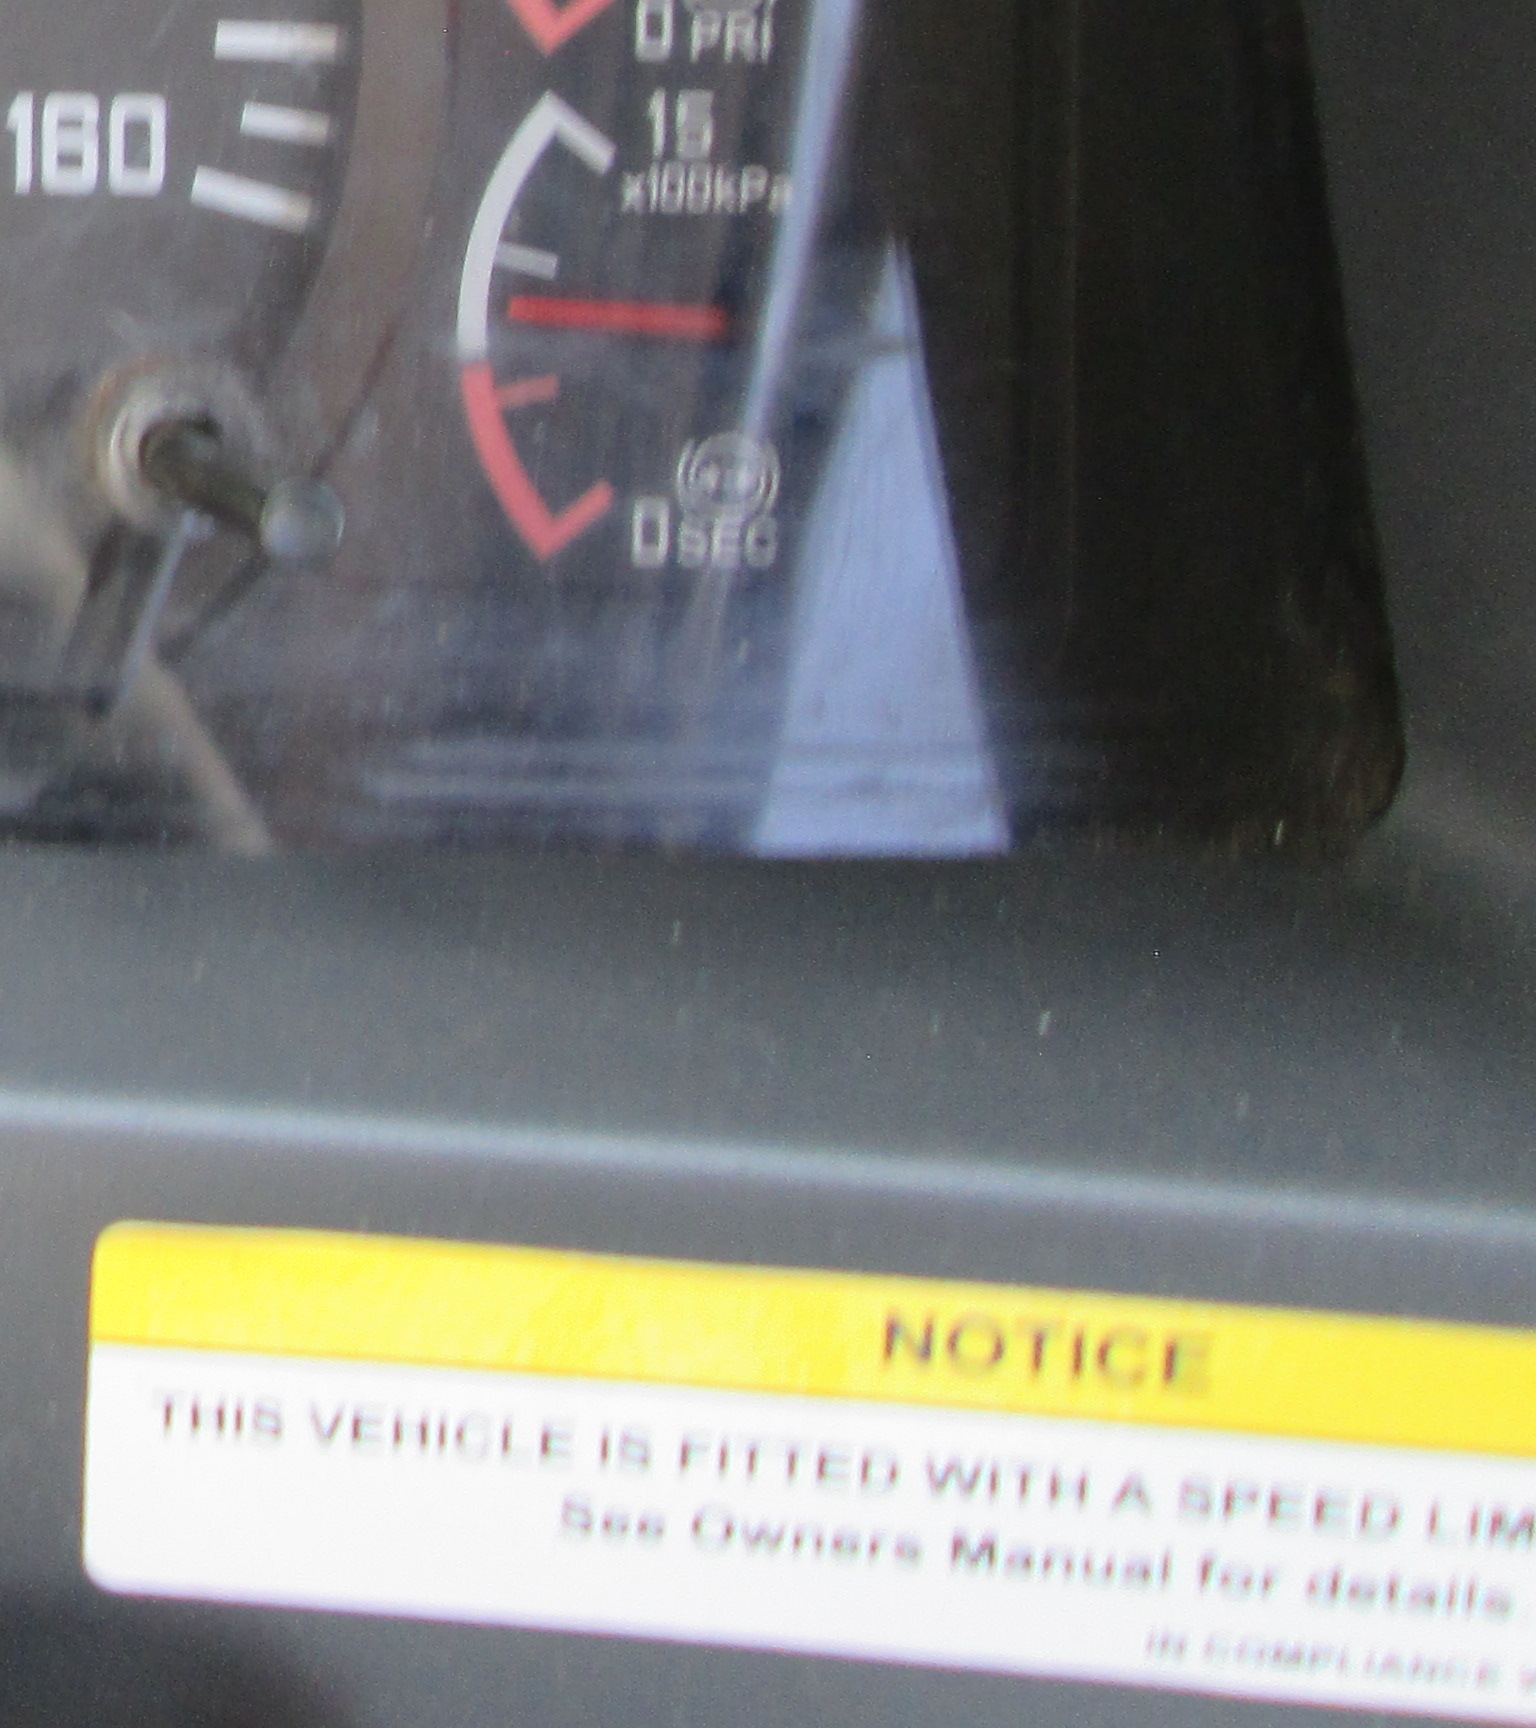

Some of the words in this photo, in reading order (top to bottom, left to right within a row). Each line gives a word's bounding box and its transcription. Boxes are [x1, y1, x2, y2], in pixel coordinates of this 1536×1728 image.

[691, 9, 773, 64] PRI
[8, 92, 168, 196] 160
[647, 90, 714, 160] 15
[631, 494, 671, 569] 0
[881, 1310, 1212, 1392] NOTICE
[153, 1389, 284, 1444] THIS
[308, 1398, 574, 1468] VEHICLE
[599, 1422, 651, 1475] IS
[678, 1430, 902, 1496] FITTED
[926, 1455, 1091, 1510] WITH
[1110, 1470, 1152, 1516] A
[1178, 1477, 1403, 1540] SPEED
[560, 1492, 666, 1546] See
[690, 1502, 922, 1560] Owners
[950, 1528, 1172, 1588] Manual
[1198, 1552, 1278, 1596] for
[1304, 1562, 1516, 1618] details
